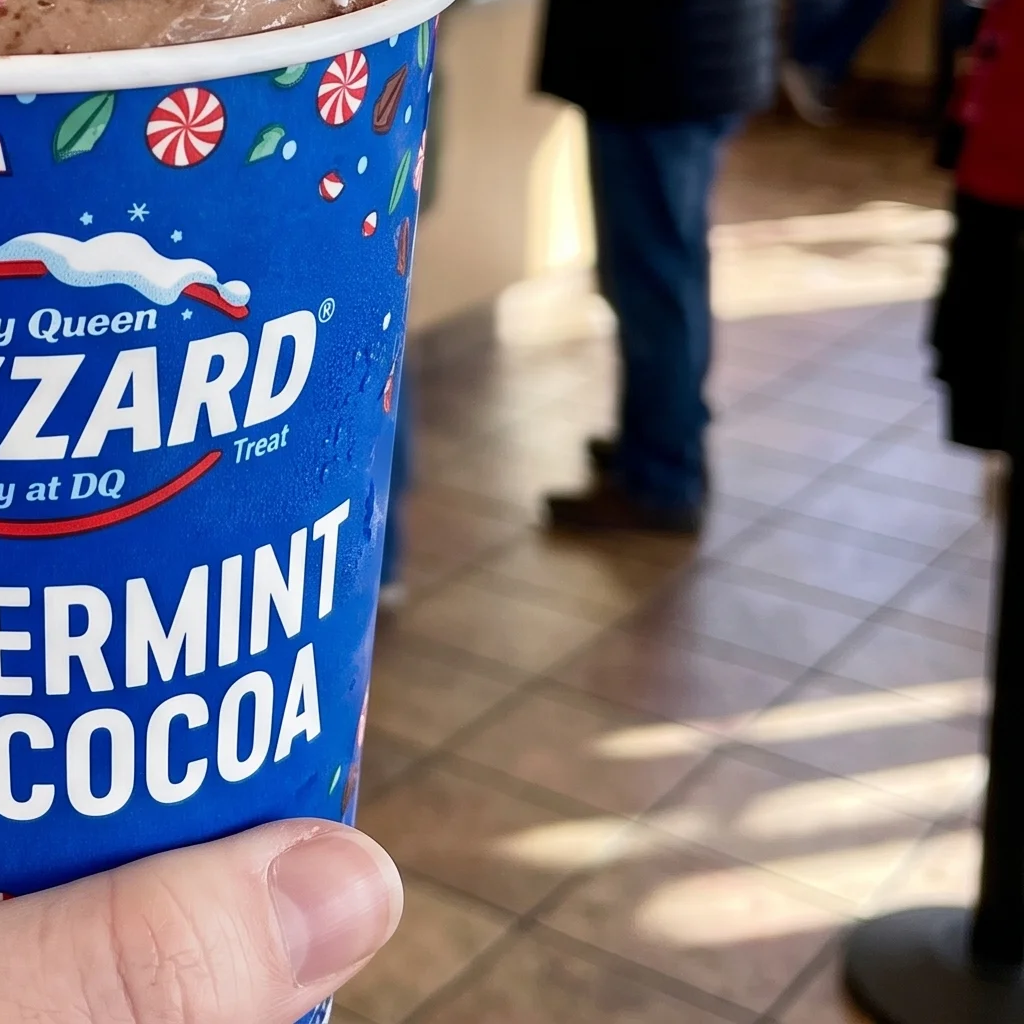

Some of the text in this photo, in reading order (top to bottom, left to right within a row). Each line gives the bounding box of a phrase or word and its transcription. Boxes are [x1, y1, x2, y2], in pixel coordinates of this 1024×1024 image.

[29, 307, 157, 343] Queen
[233, 424, 289, 464] Treat
[26, 476, 61, 501] at
[70, 469, 126, 500] DQ
